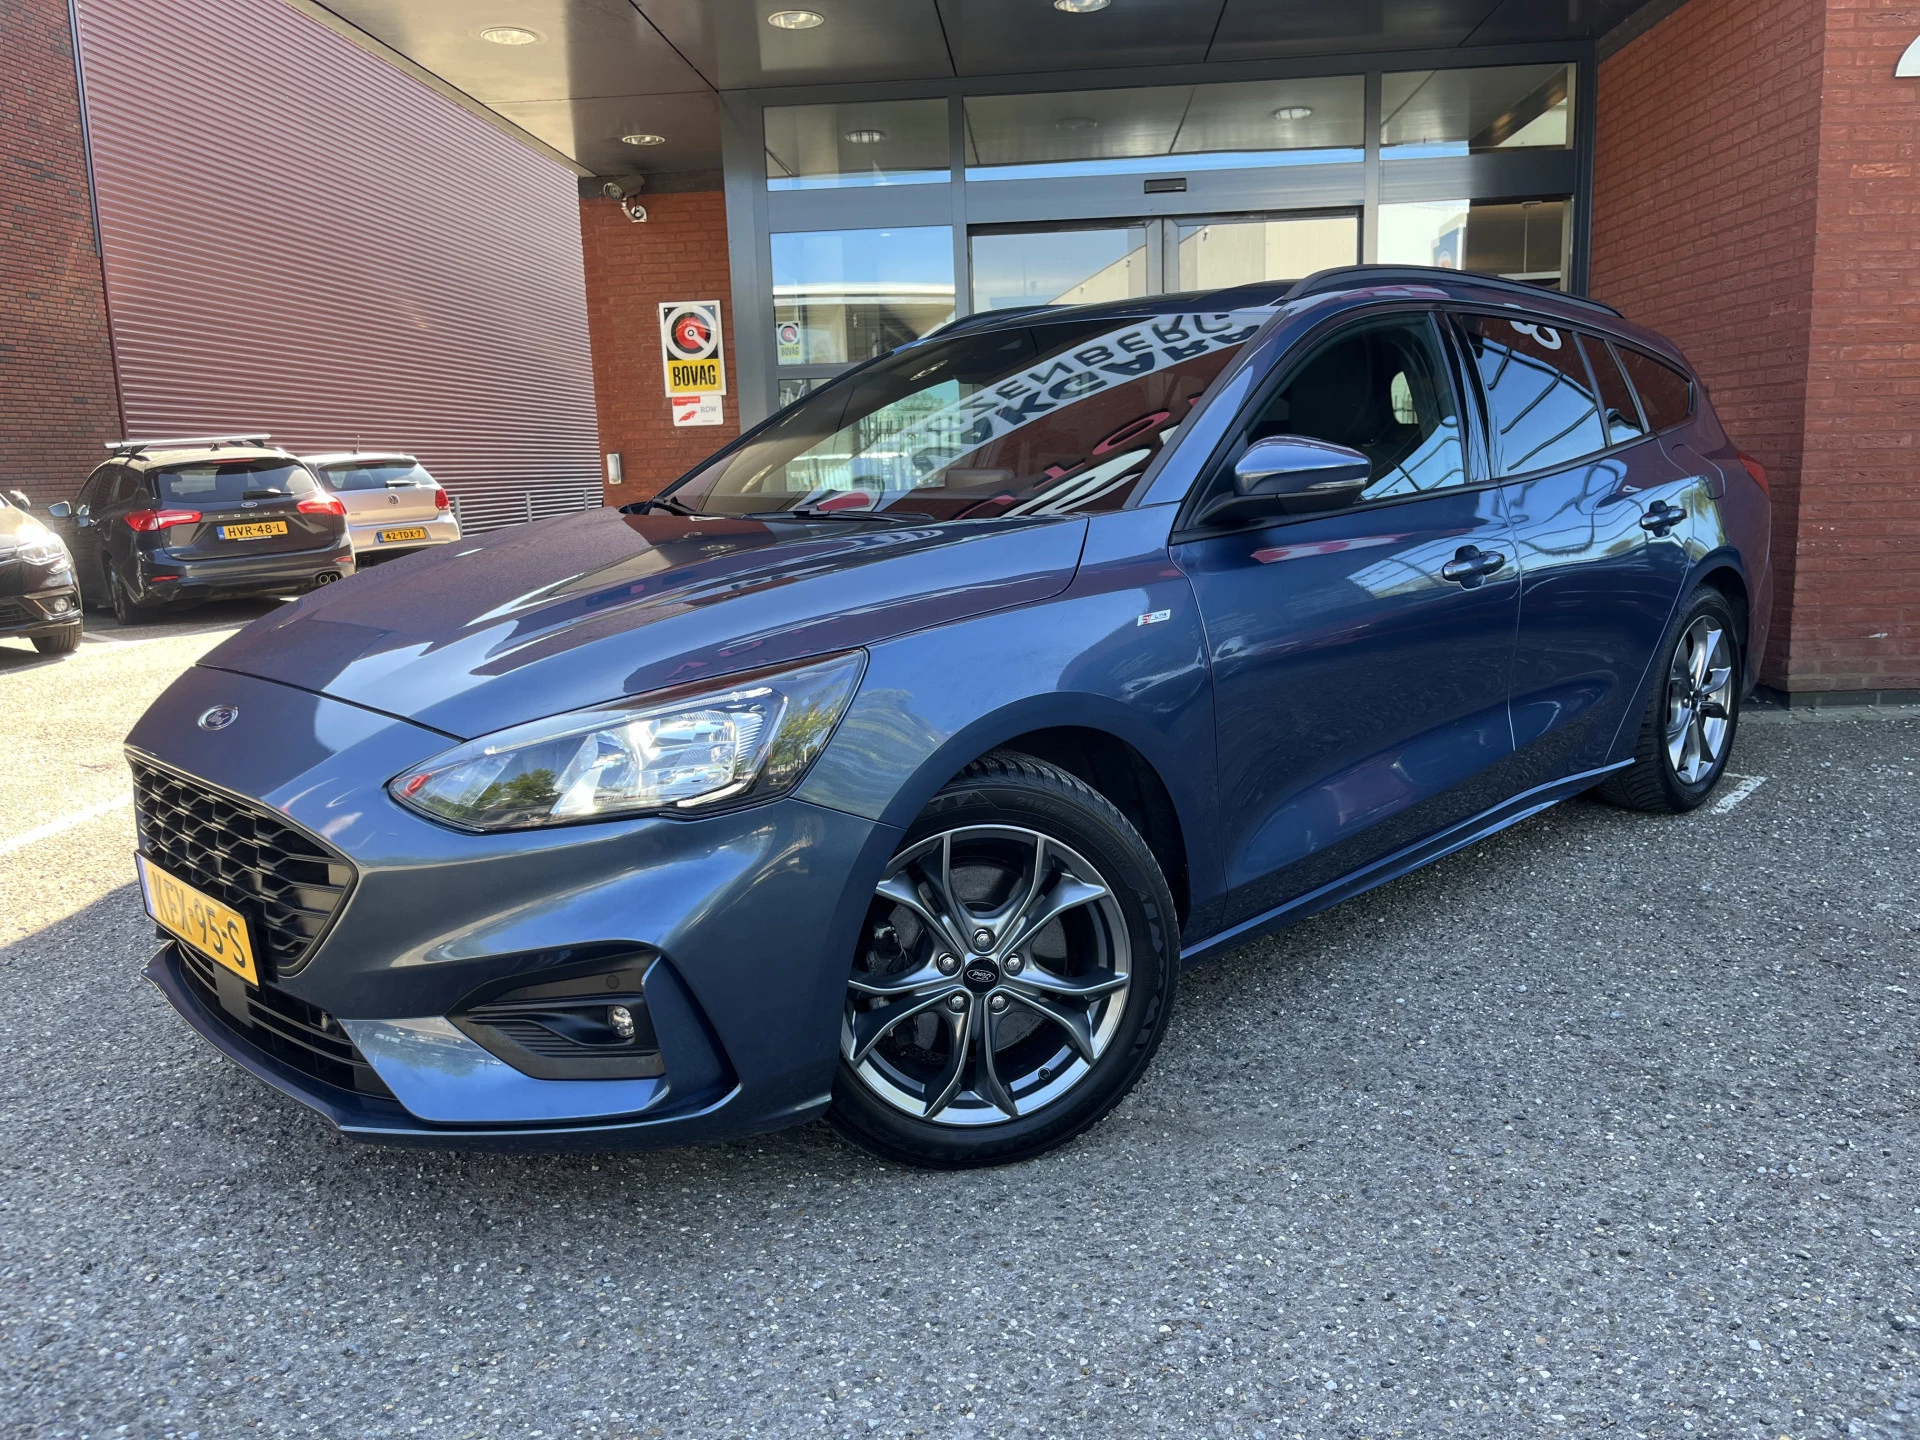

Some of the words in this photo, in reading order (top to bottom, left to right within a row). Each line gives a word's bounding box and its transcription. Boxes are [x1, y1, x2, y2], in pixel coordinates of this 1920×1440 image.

[781, 347, 799, 356] BOVAG
[673, 365, 716, 386] BOVAG
[228, 523, 284, 537] HVR-48-L
[386, 530, 421, 540] 42-TDX-7
